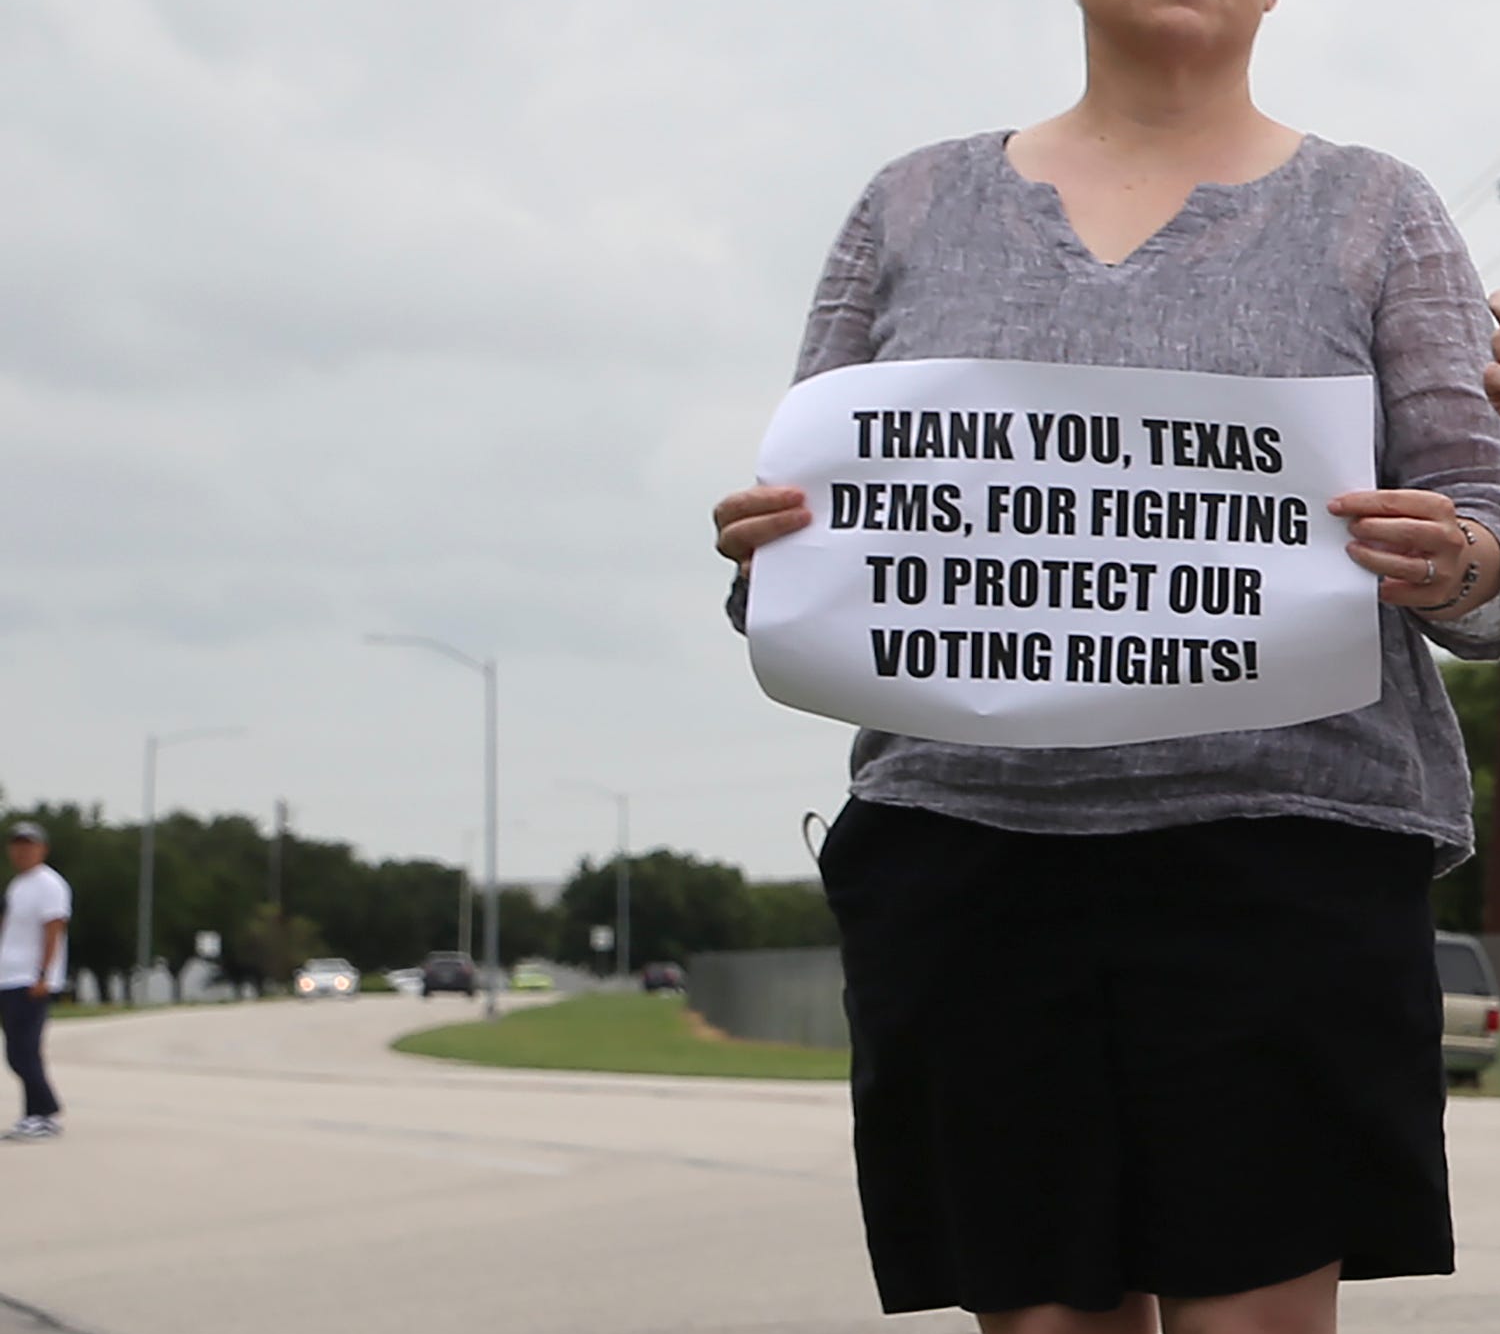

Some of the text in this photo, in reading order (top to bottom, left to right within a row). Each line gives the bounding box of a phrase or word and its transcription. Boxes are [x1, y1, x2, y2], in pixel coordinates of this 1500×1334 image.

[853, 410, 1283, 474] THANK YOU, TEXAS
[830, 483, 1308, 546] DEMS, FOR FIGHTING
[865, 555, 1262, 616] TO PROTECT OUR
[870, 628, 1259, 686] VOTING RIGHTS!
